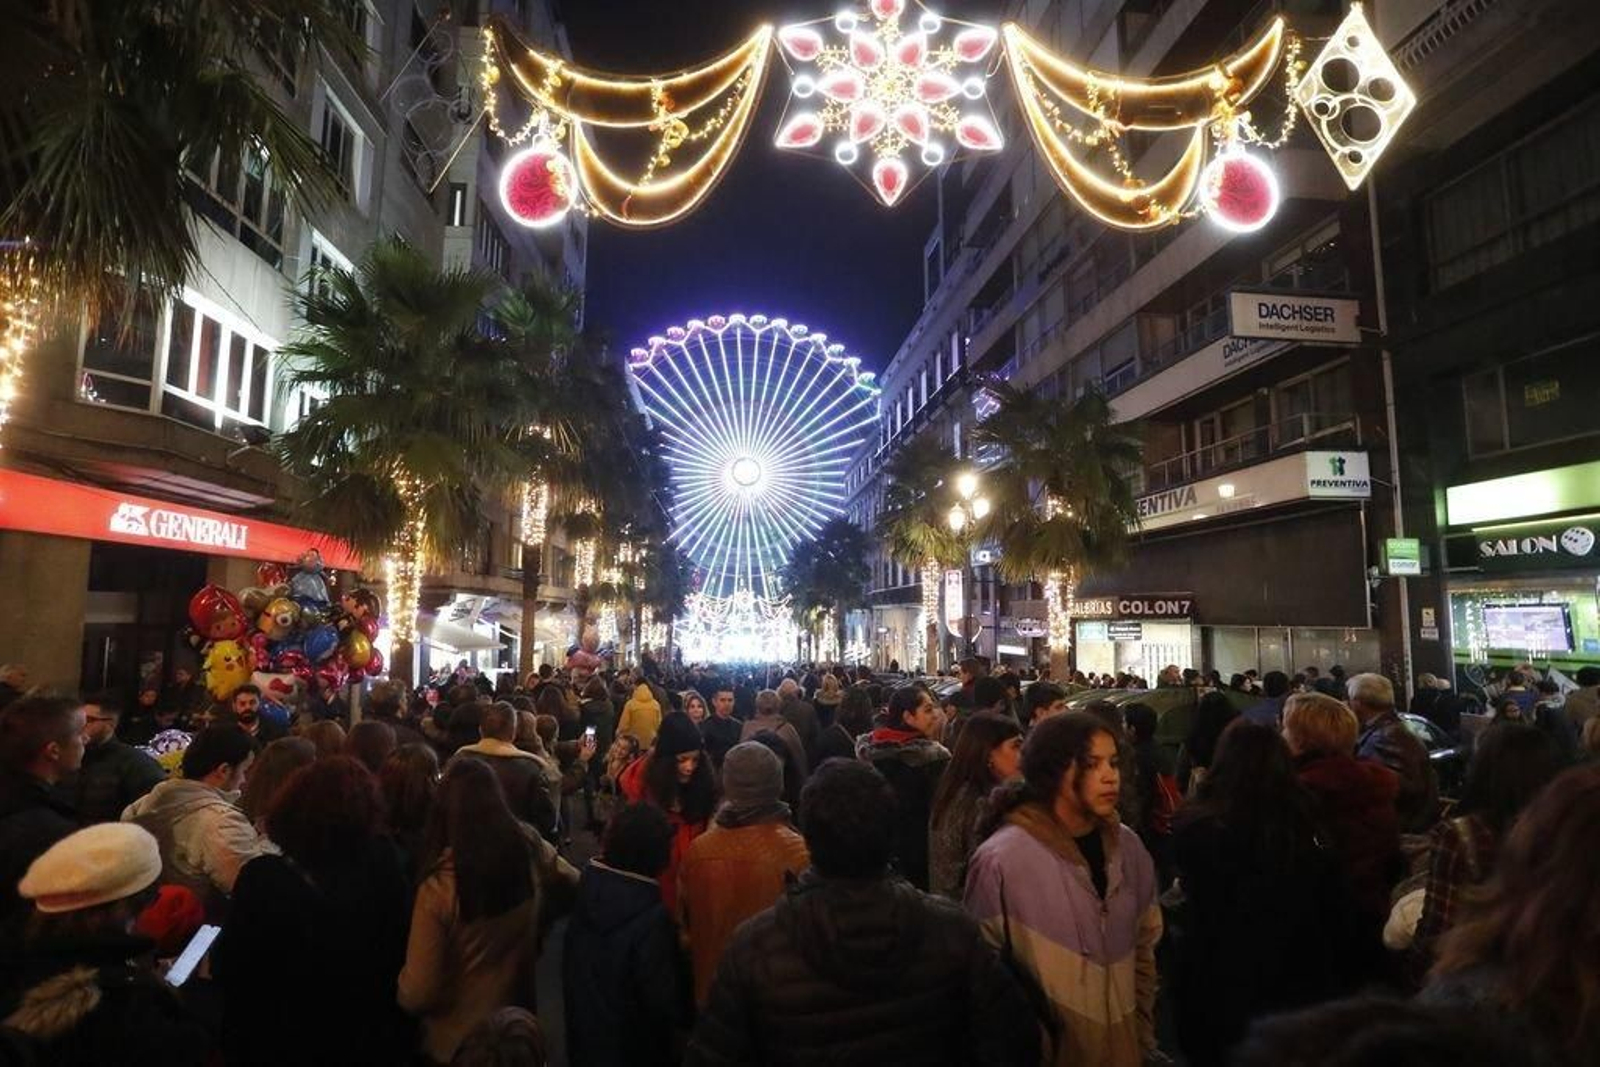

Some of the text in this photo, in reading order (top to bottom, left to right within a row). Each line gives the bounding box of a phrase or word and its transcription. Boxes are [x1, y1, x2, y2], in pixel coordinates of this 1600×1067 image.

[1258, 303, 1335, 323] DACHSER
[1259, 321, 1336, 334] Intelligent Logistics
[1310, 479, 1369, 488] PREVENTIVA
[151, 508, 249, 550] GENERALI
[1480, 534, 1558, 557] SALON
